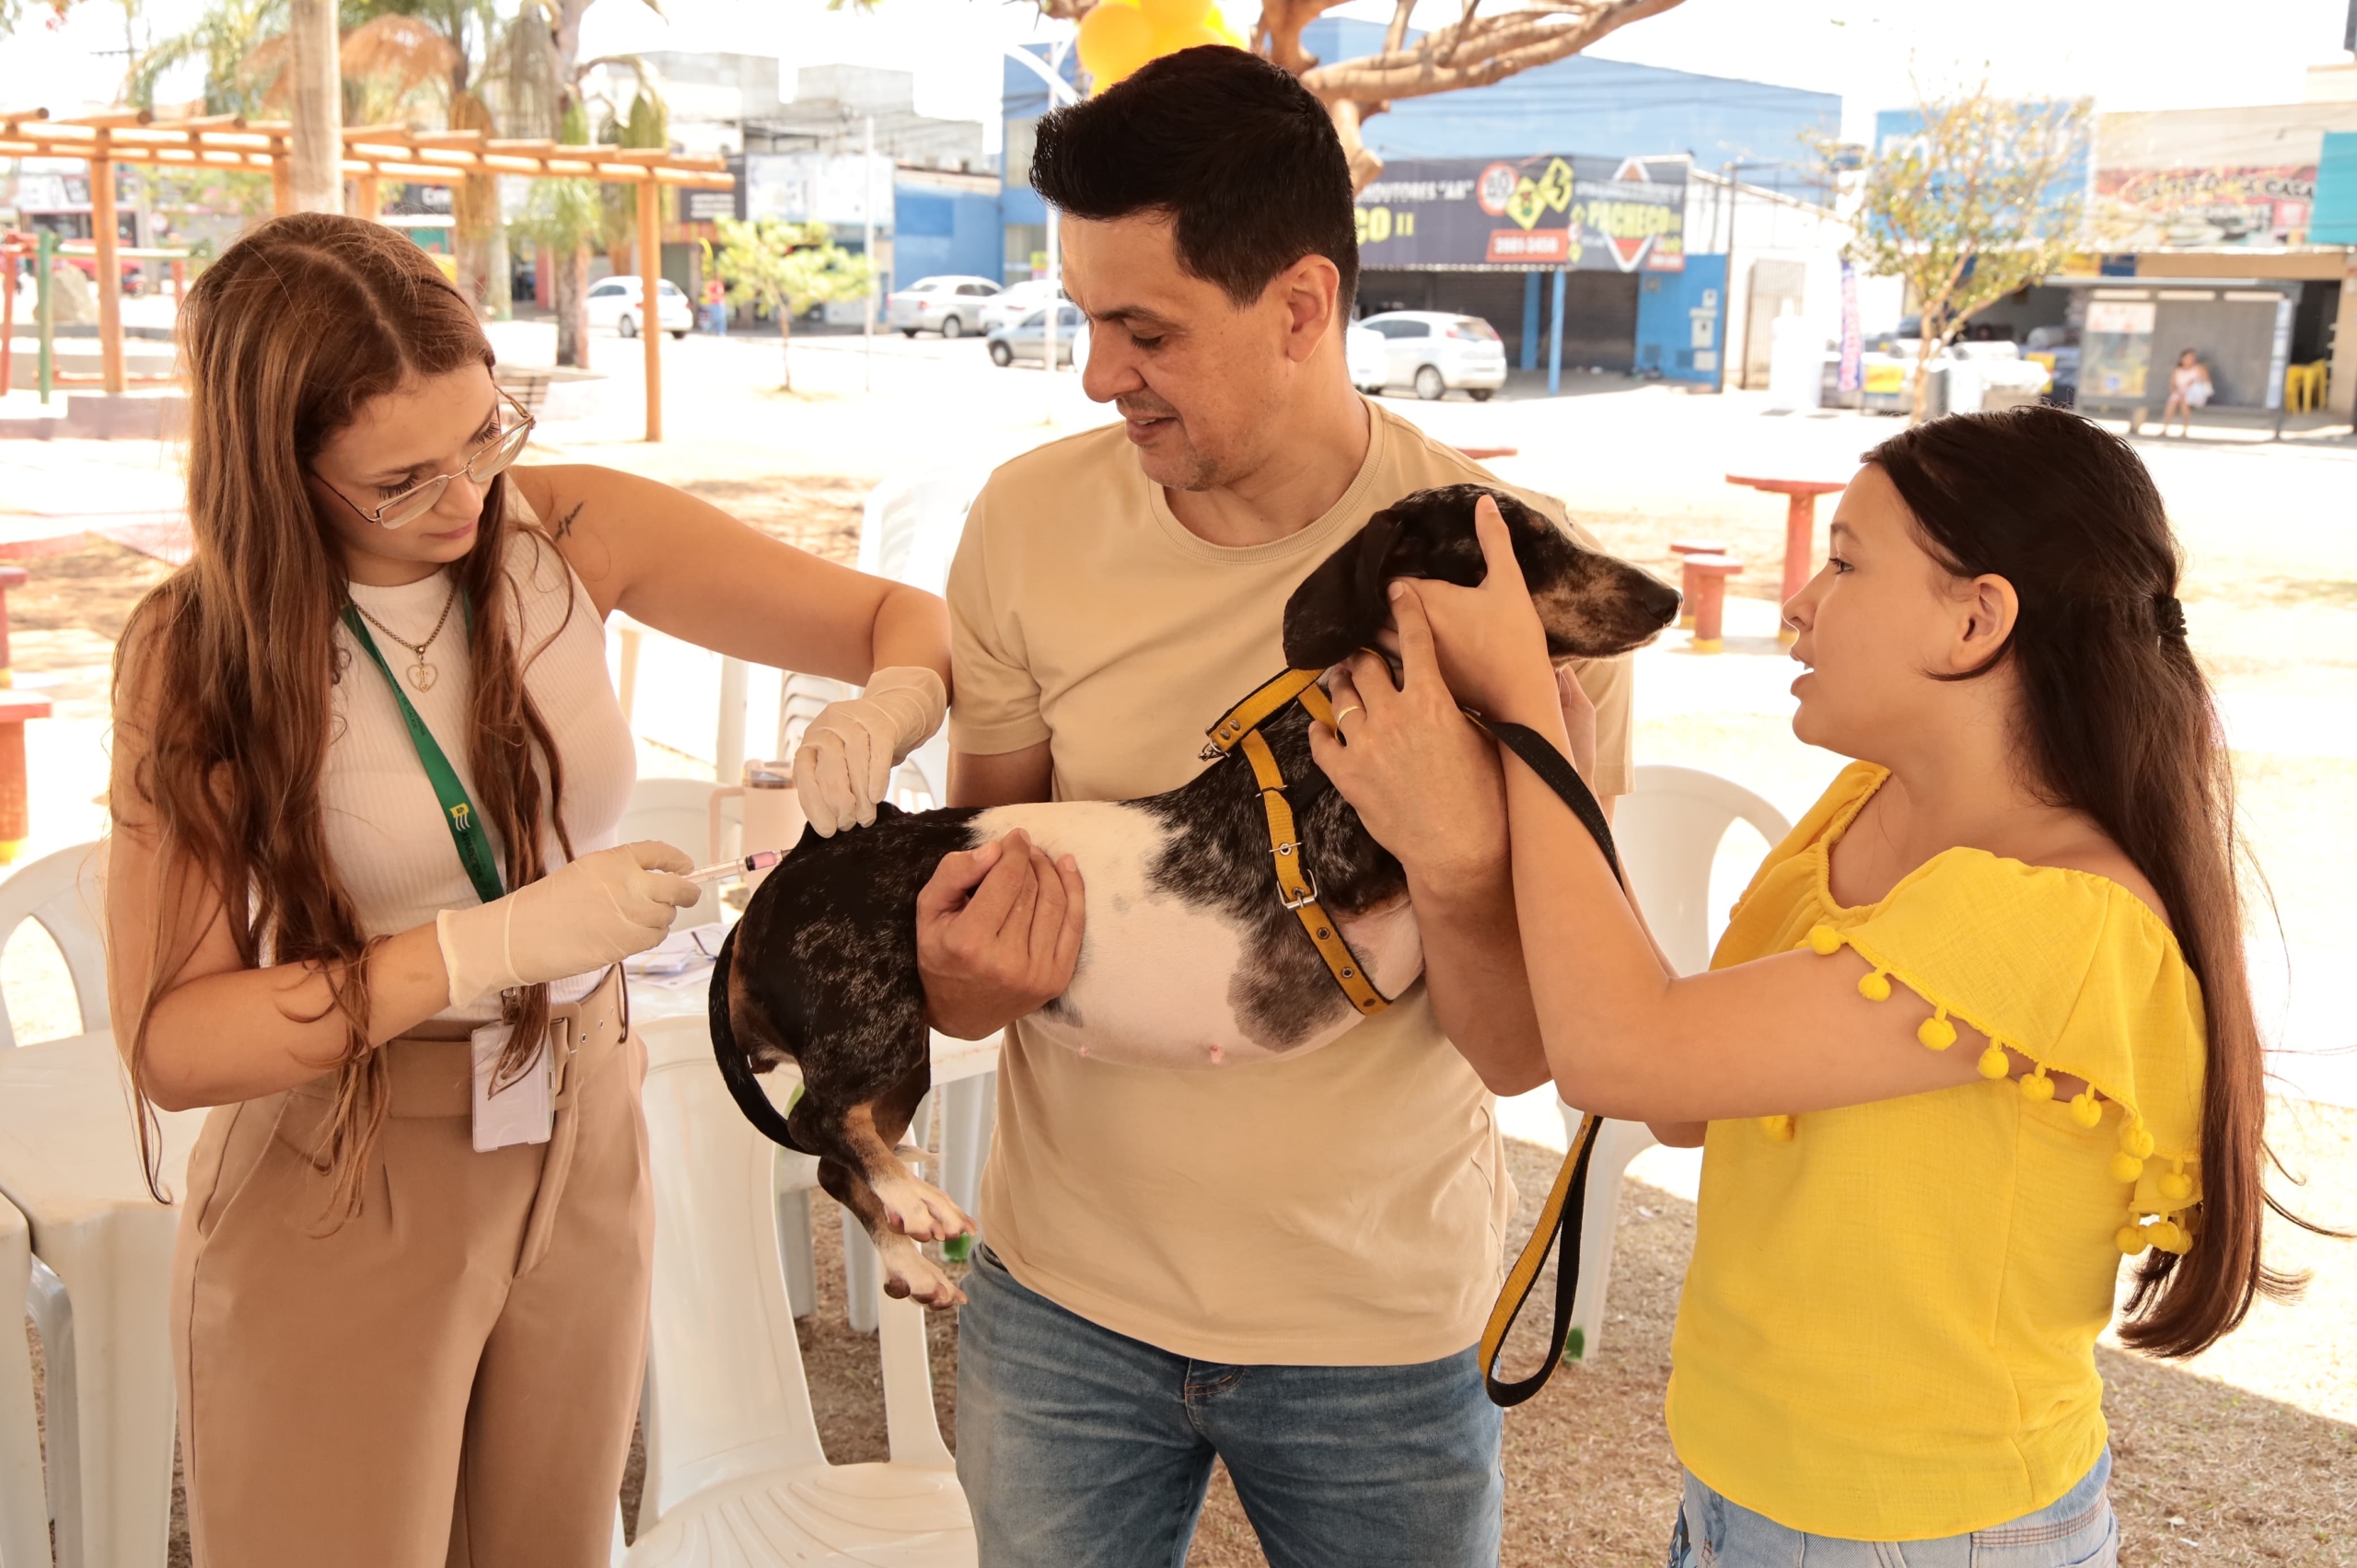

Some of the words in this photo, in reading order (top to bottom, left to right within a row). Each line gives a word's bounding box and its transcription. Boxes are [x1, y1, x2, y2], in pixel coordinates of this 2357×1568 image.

[1396, 212, 1414, 236] II
[1586, 200, 1672, 238] PACHECO
[461, 832, 483, 878] APARECIDA
